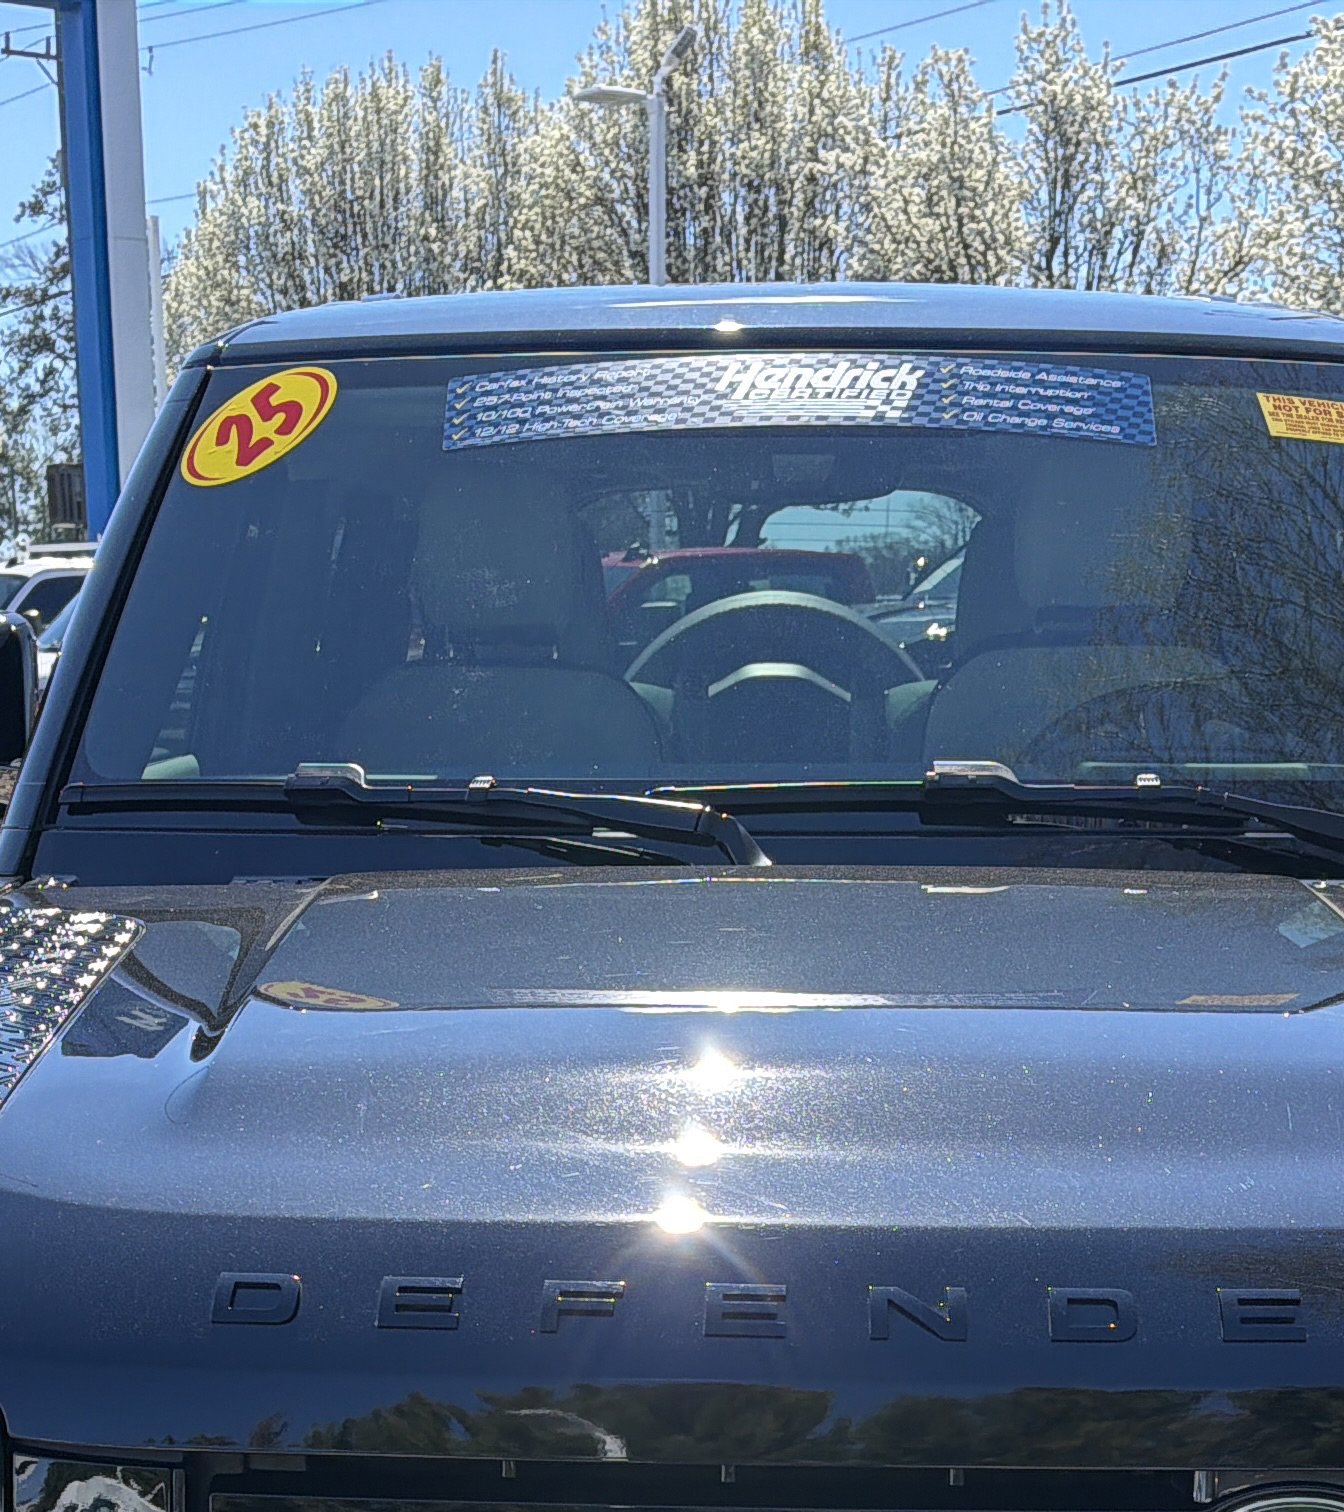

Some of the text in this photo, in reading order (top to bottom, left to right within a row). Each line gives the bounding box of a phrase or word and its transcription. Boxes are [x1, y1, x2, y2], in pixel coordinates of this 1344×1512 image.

[714, 361, 926, 400] Hendrick
[959, 366, 1031, 380] Roadside
[475, 378, 527, 392] Carfax
[532, 373, 591, 387] History
[962, 381, 990, 392] Trip
[473, 391, 553, 407] 257-Point
[748, 387, 913, 400] CERTIFIED
[961, 395, 1013, 408] Rental
[1263, 395, 1295, 405] THIS
[476, 406, 533, 421] 10/100
[535, 400, 623, 416] Powertrain
[1272, 403, 1300, 412] NOT
[1305, 407, 1333, 417] FOR
[214, 381, 304, 467] 25
[475, 423, 520, 437] 12/12
[522, 417, 597, 433] High-Tech
[962, 411, 1121, 433] Oil Change Services
